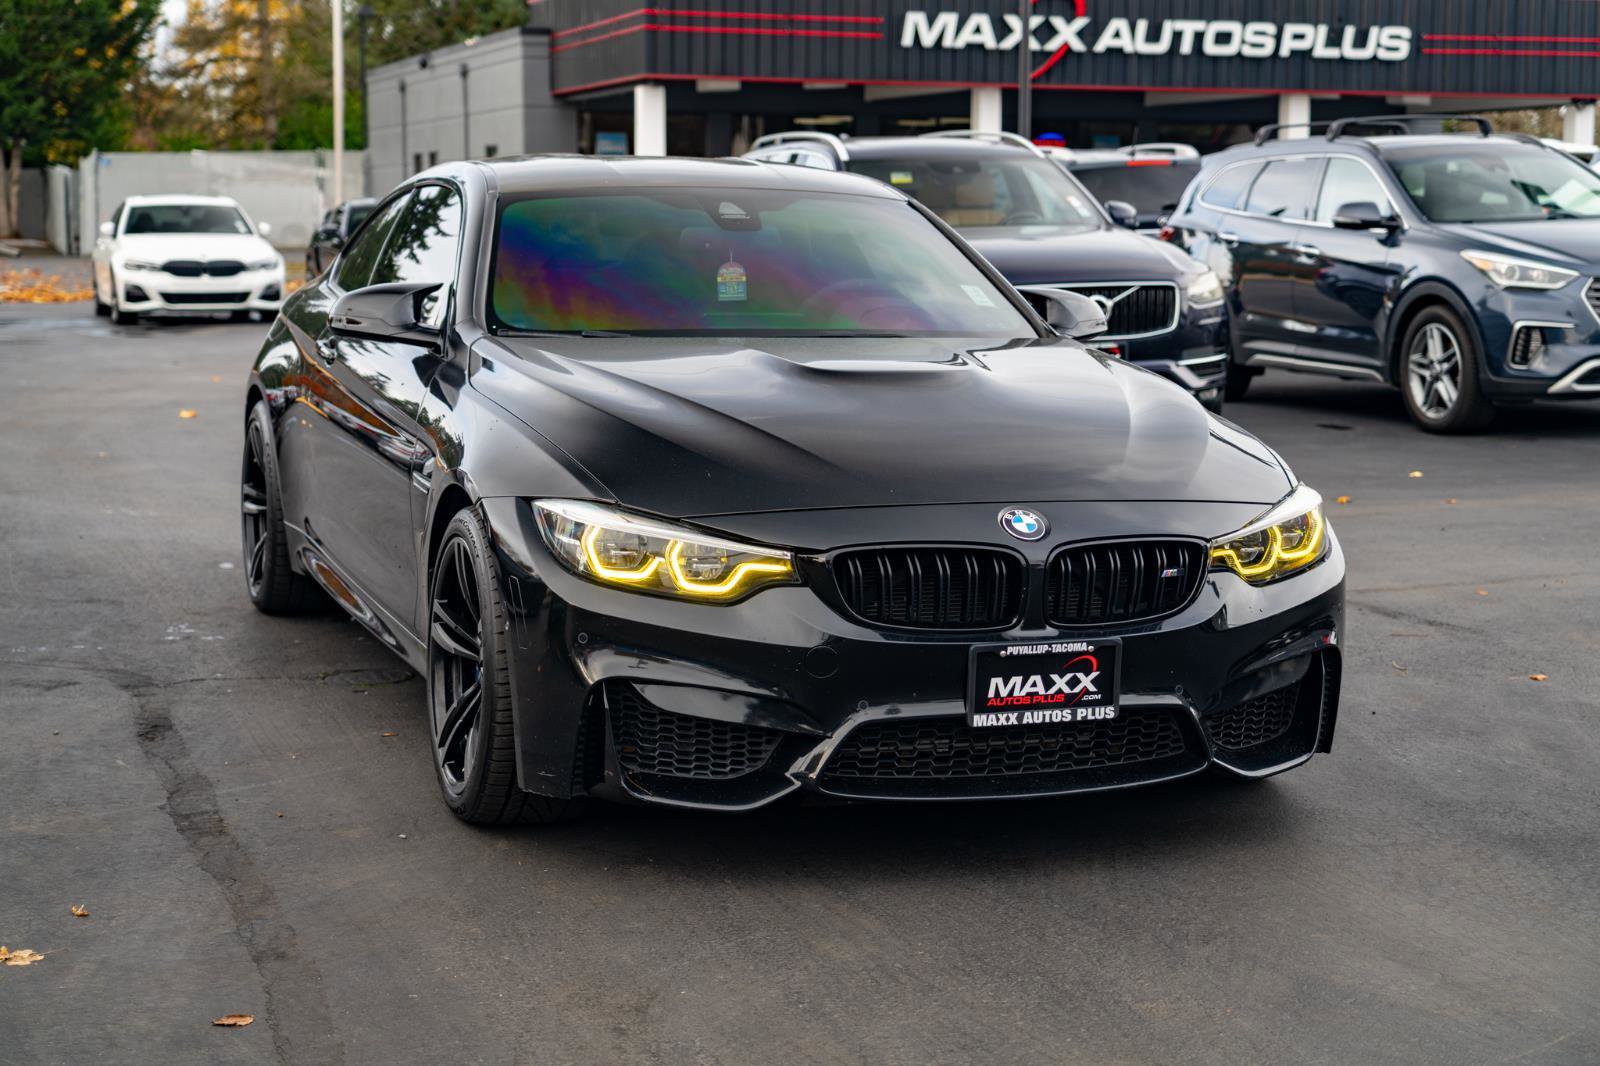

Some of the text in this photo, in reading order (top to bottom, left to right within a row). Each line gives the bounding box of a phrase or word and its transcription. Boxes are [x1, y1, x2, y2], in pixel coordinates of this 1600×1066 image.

[900, 10, 1412, 61] MAXX AUTOS PLUS
[987, 671, 1101, 698] MAXX
[986, 693, 1066, 707] AUTOS PLUS
[973, 706, 1116, 728] MAXX AUTOS PLUS
